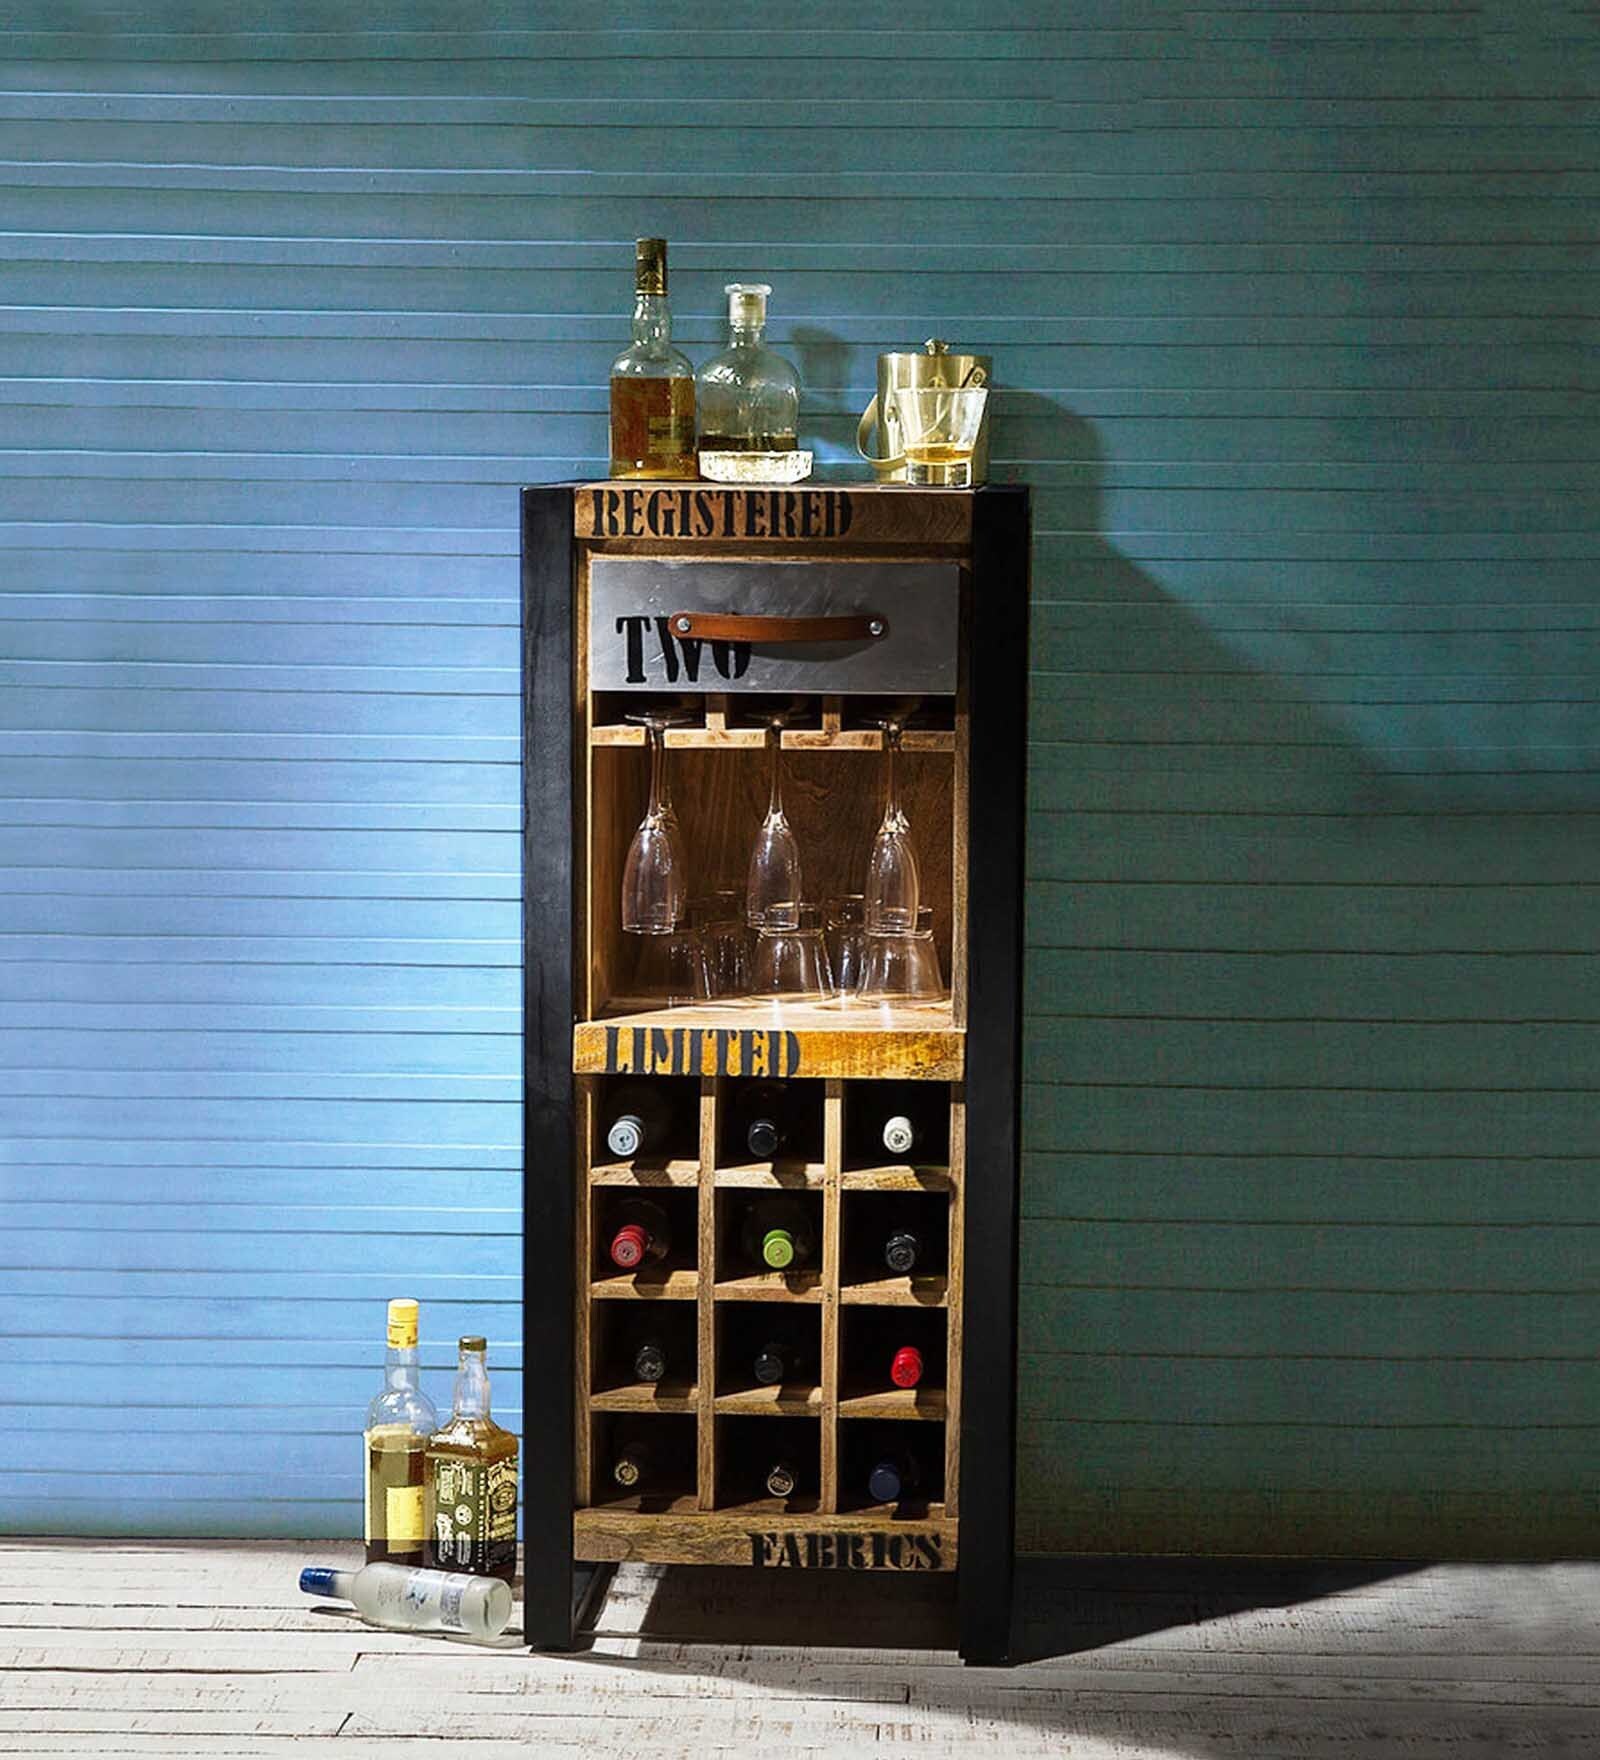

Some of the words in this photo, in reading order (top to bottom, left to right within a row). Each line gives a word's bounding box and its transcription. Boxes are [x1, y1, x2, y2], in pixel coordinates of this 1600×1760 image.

[591, 489, 853, 537] REGISTERED
[615, 613, 751, 683] TWO
[605, 1027, 800, 1076] LIMITED
[748, 1531, 942, 1568] FABRICS
